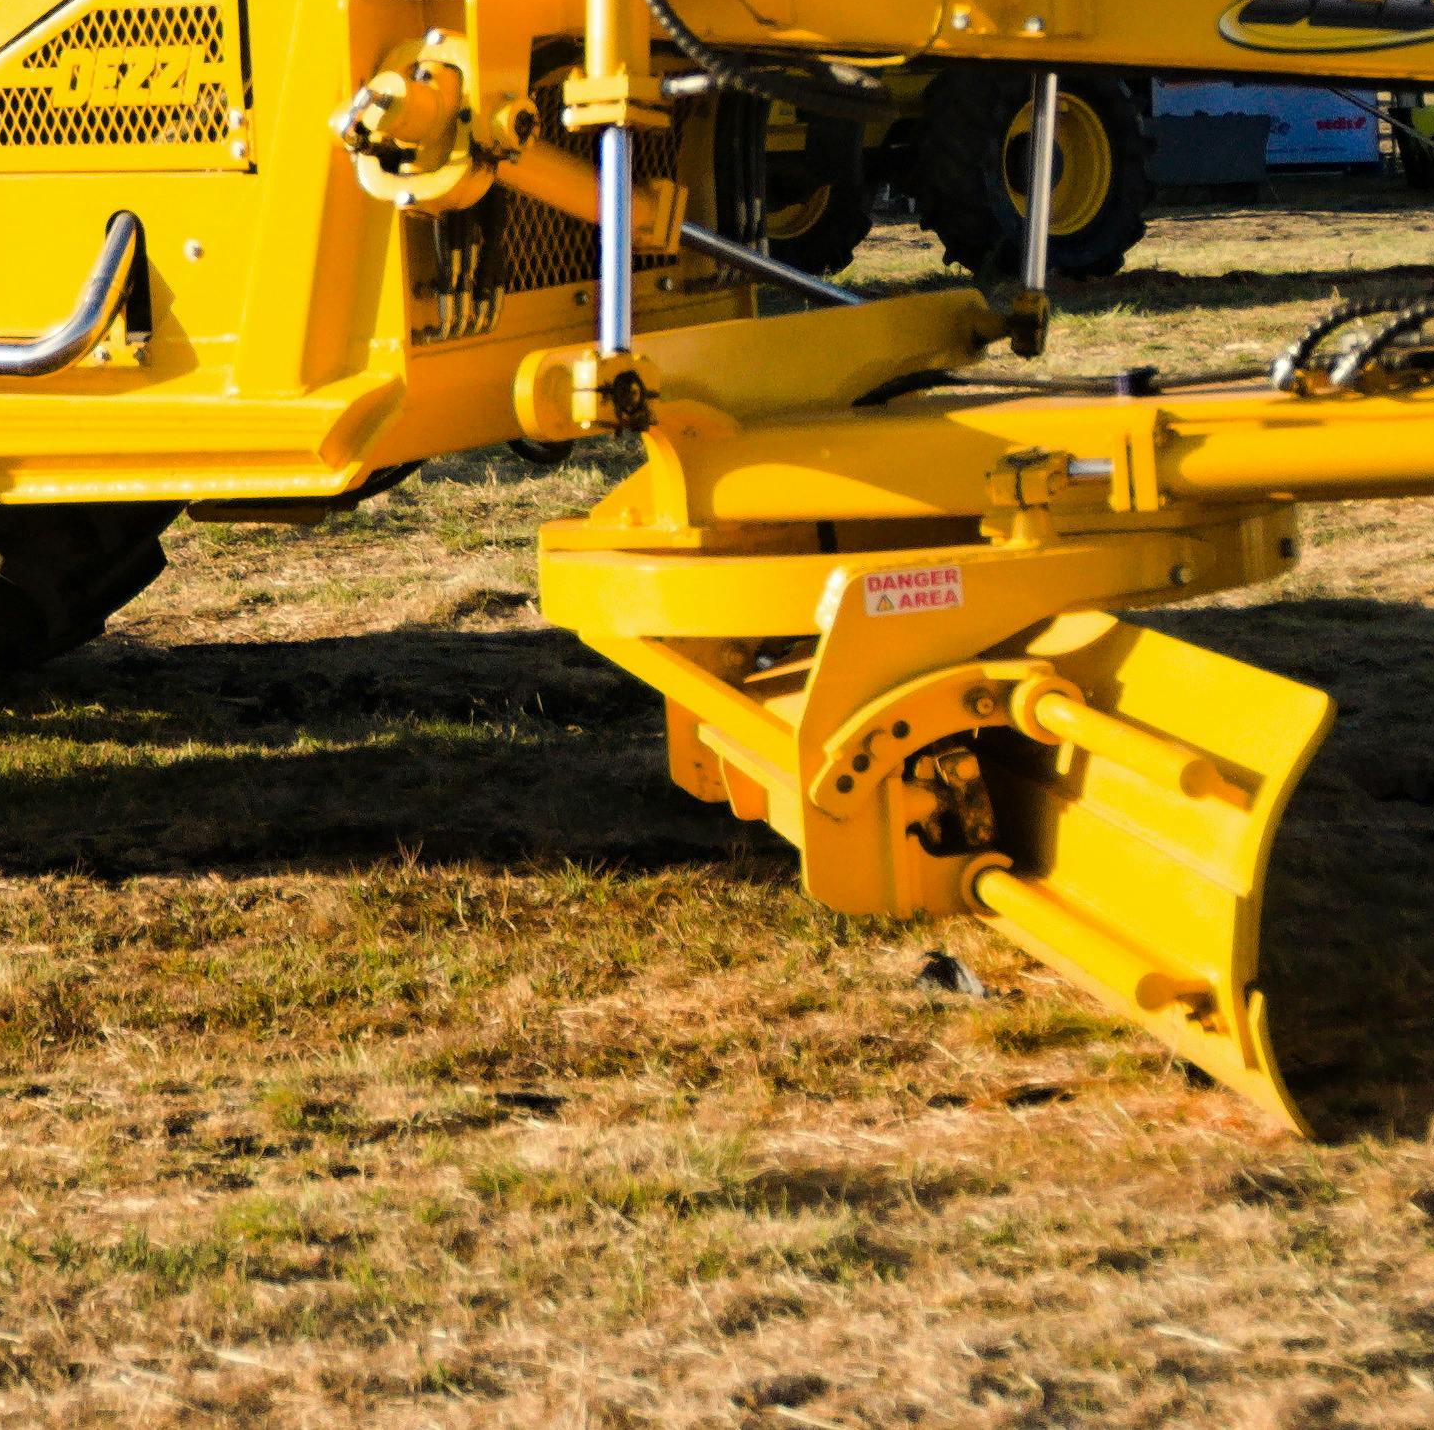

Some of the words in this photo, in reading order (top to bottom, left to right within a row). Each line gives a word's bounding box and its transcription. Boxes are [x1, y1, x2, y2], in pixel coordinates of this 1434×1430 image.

[51, 45, 206, 109] DEZZI
[866, 568, 959, 593] DANGER
[898, 589, 959, 610] AREA
